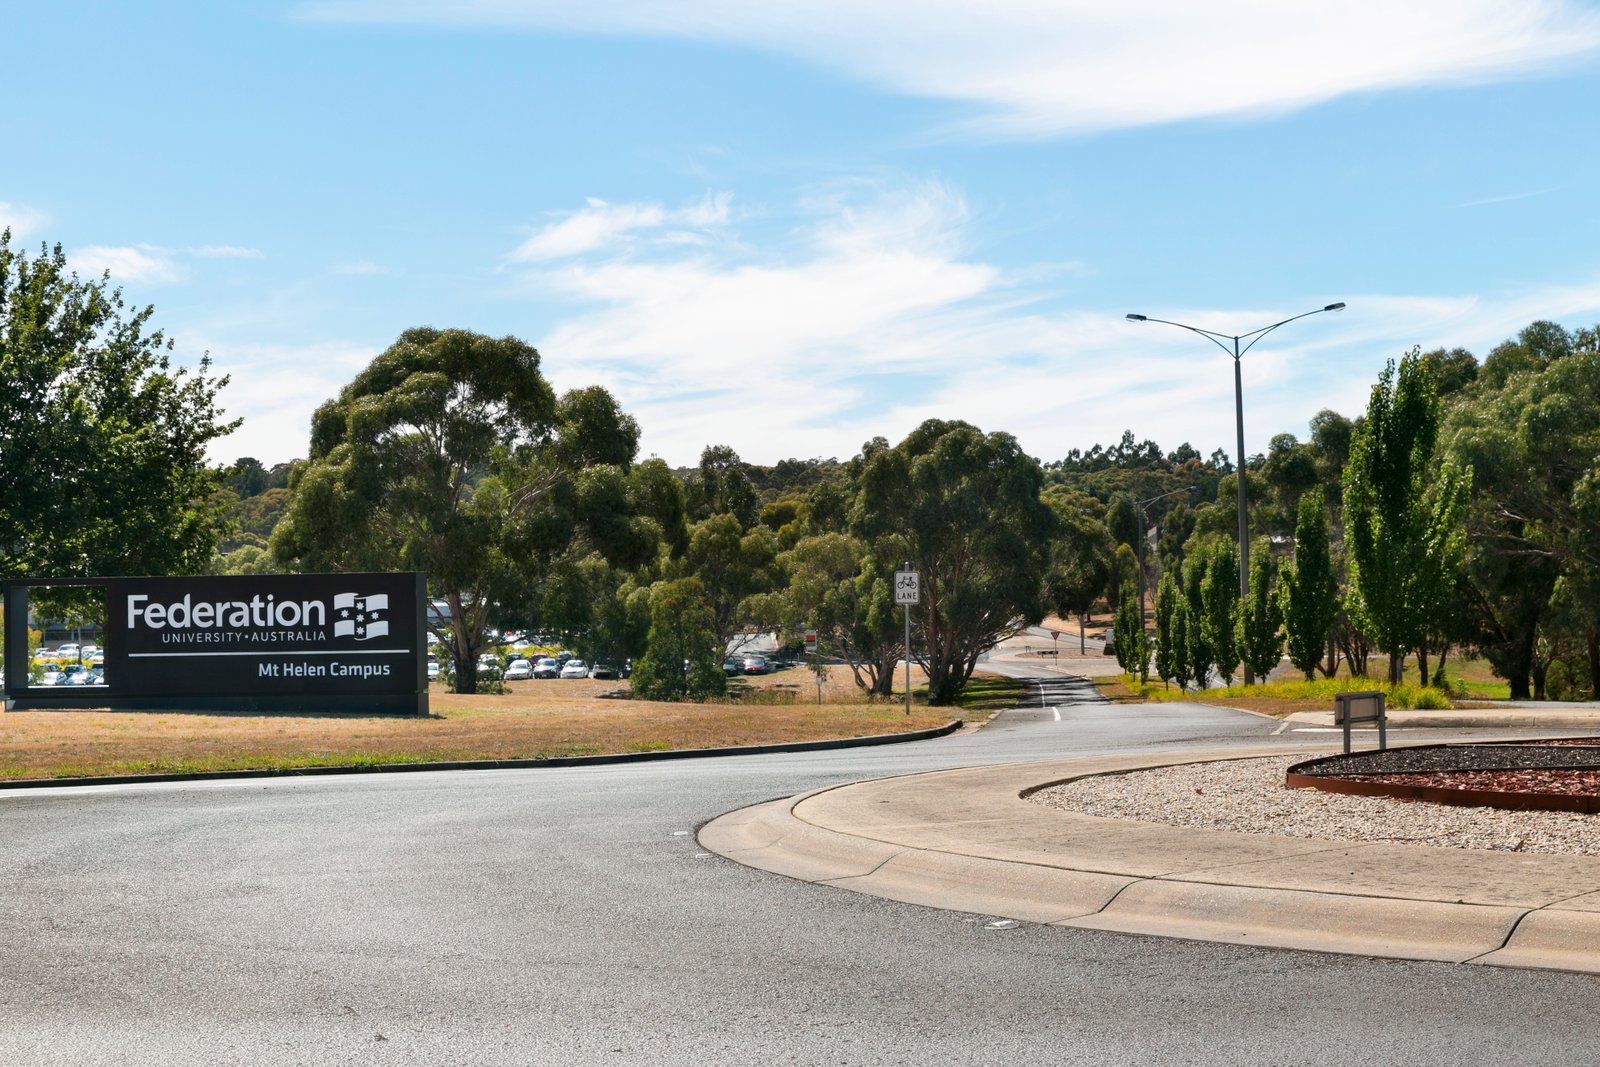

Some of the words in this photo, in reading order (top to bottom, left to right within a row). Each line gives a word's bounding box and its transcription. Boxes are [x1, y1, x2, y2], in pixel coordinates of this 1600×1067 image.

[897, 592, 917, 600] LANE
[127, 593, 326, 629] Federation
[258, 662, 280, 678] Mt
[283, 661, 326, 677] Helen
[330, 661, 391, 681] Campus
